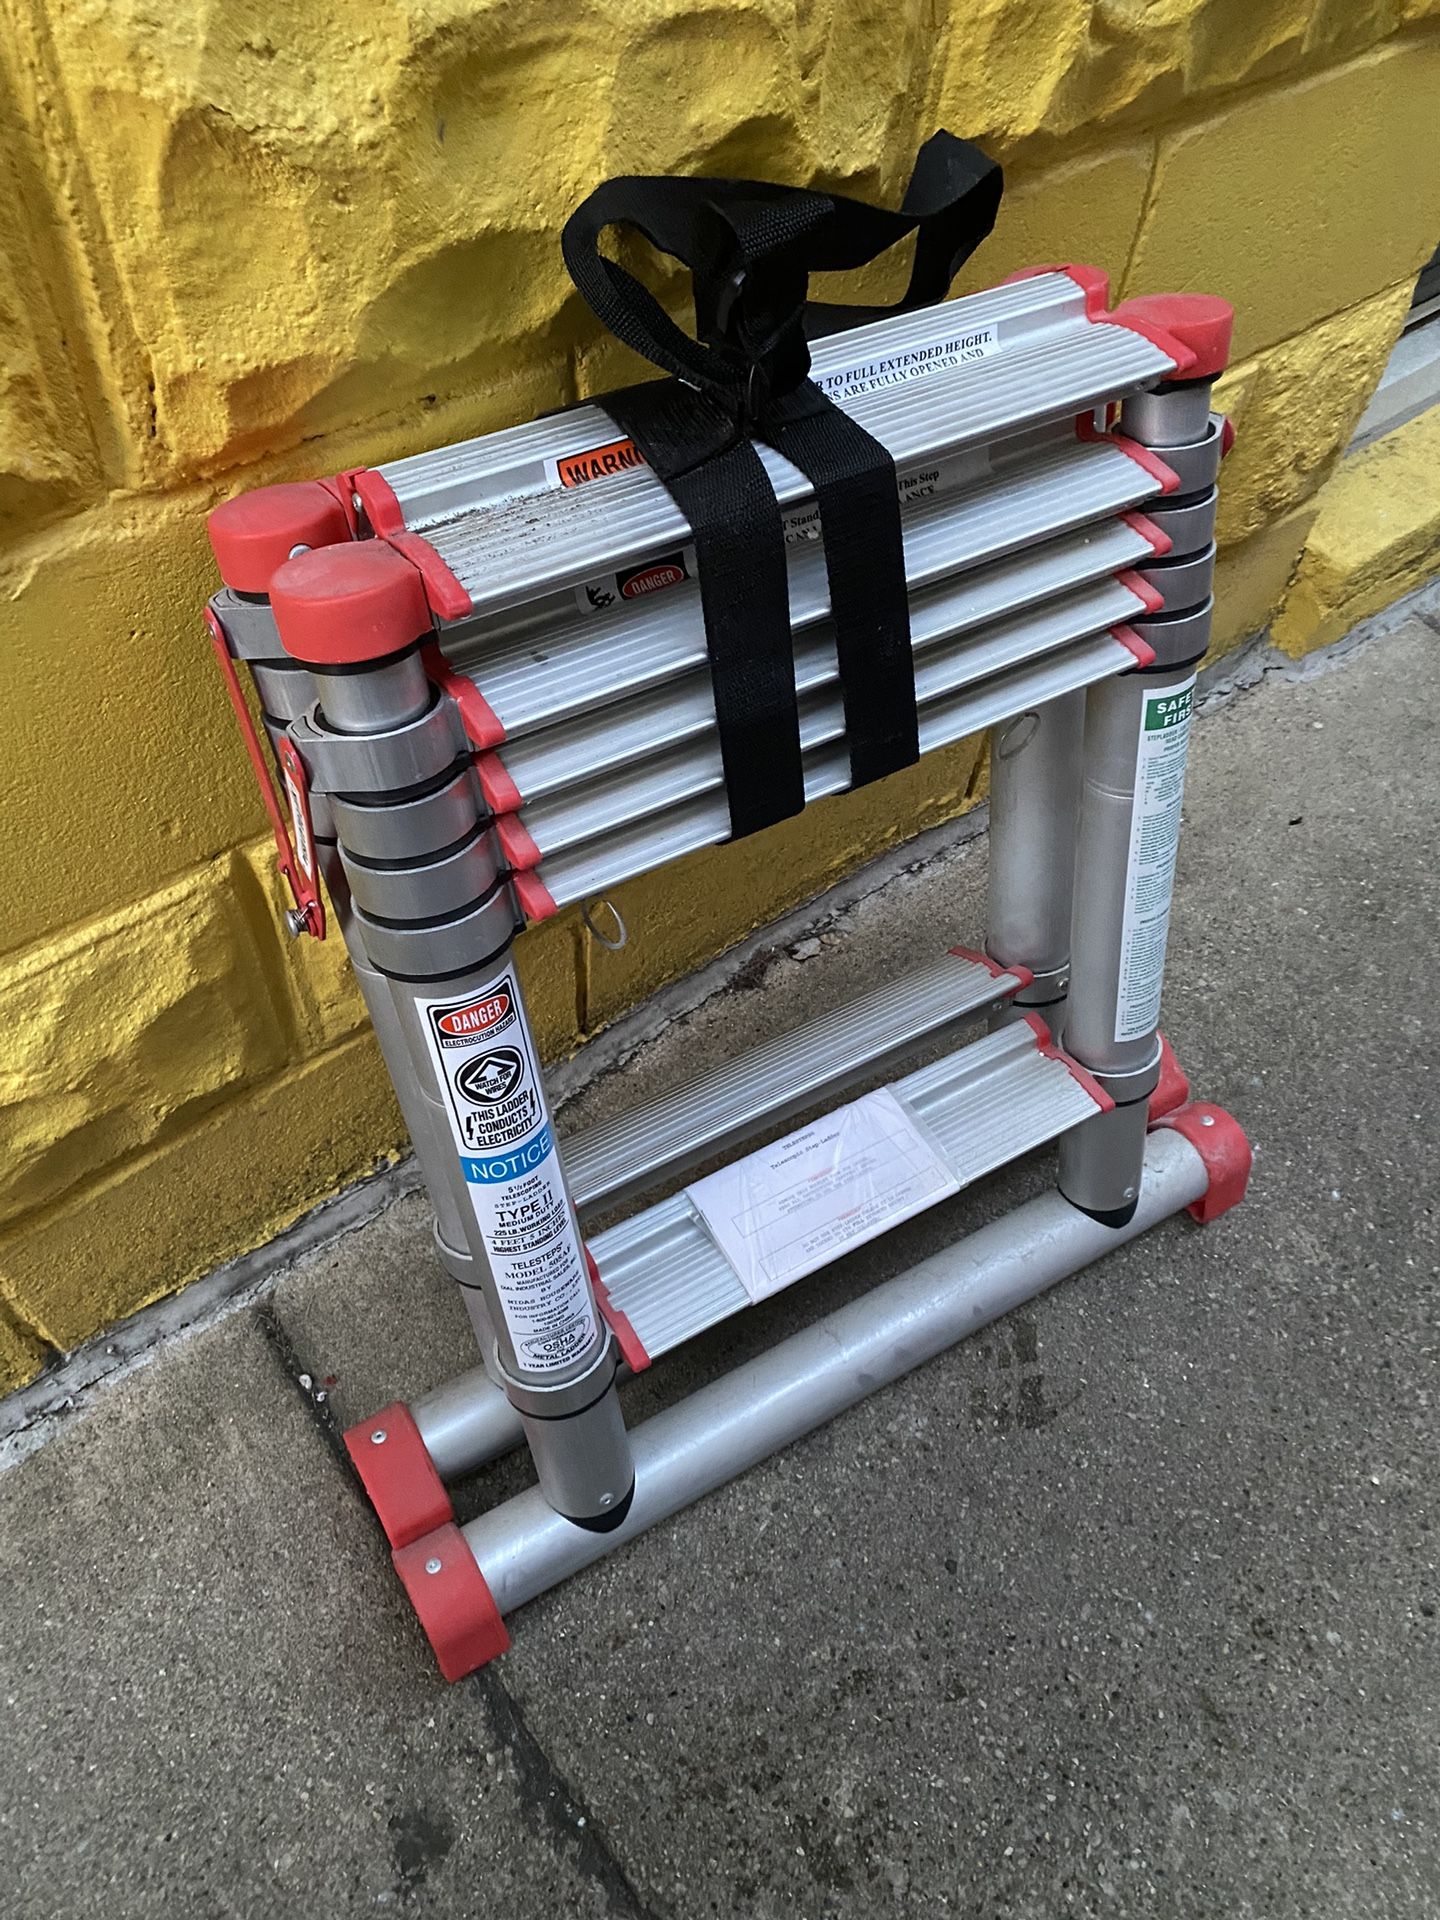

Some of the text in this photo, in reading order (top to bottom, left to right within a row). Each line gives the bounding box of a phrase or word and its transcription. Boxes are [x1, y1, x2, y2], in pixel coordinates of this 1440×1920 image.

[826, 375, 843, 389] TO
[846, 365, 877, 383] FULL
[879, 346, 943, 373] EXTENDED
[945, 331, 992, 354] HEIGHT.
[844, 382, 869, 397] ARE
[869, 369, 907, 389] FULLY
[909, 356, 958, 376] OPENED
[960, 348, 984, 362] AND
[899, 470, 939, 491] This Step
[790, 510, 819, 528] Stand
[631, 569, 676, 594] DANGER
[451, 1001, 502, 1032] DANGER
[445, 1015, 514, 1046] ELECTROCUTION HAZARD
[475, 1070, 512, 1090] WATCH FOR
[485, 1082, 507, 1095] WIRES
[471, 1089, 529, 1122] THIS LADDER
[478, 1105, 528, 1134] CONDUCTS
[476, 1116, 533, 1147] ELECTRICITY
[471, 1131, 550, 1179] NOTICE
[501, 1180, 542, 1201] TELESCOPING
[522, 1175, 539, 1188] FOOT
[494, 1181, 551, 1208] STEP-LADDER
[495, 1190, 553, 1221] TYPE II
[498, 1201, 554, 1228] MEDIUM DUTY
[519, 1213, 551, 1233] WORKING
[500, 1236, 526, 1246] FEET
[538, 1211, 565, 1236] INCHES
[522, 1232, 553, 1249] STANDING
[505, 1266, 547, 1279] MODEL
[516, 1266, 559, 1285] MANUFACTURED
[540, 1285, 552, 1293] BY
[509, 1300, 552, 1311] INDUSTRY
[543, 1333, 576, 1351] OSHA
[561, 1333, 586, 1356] LADDER
[545, 1356, 571, 1367] LIMITED
